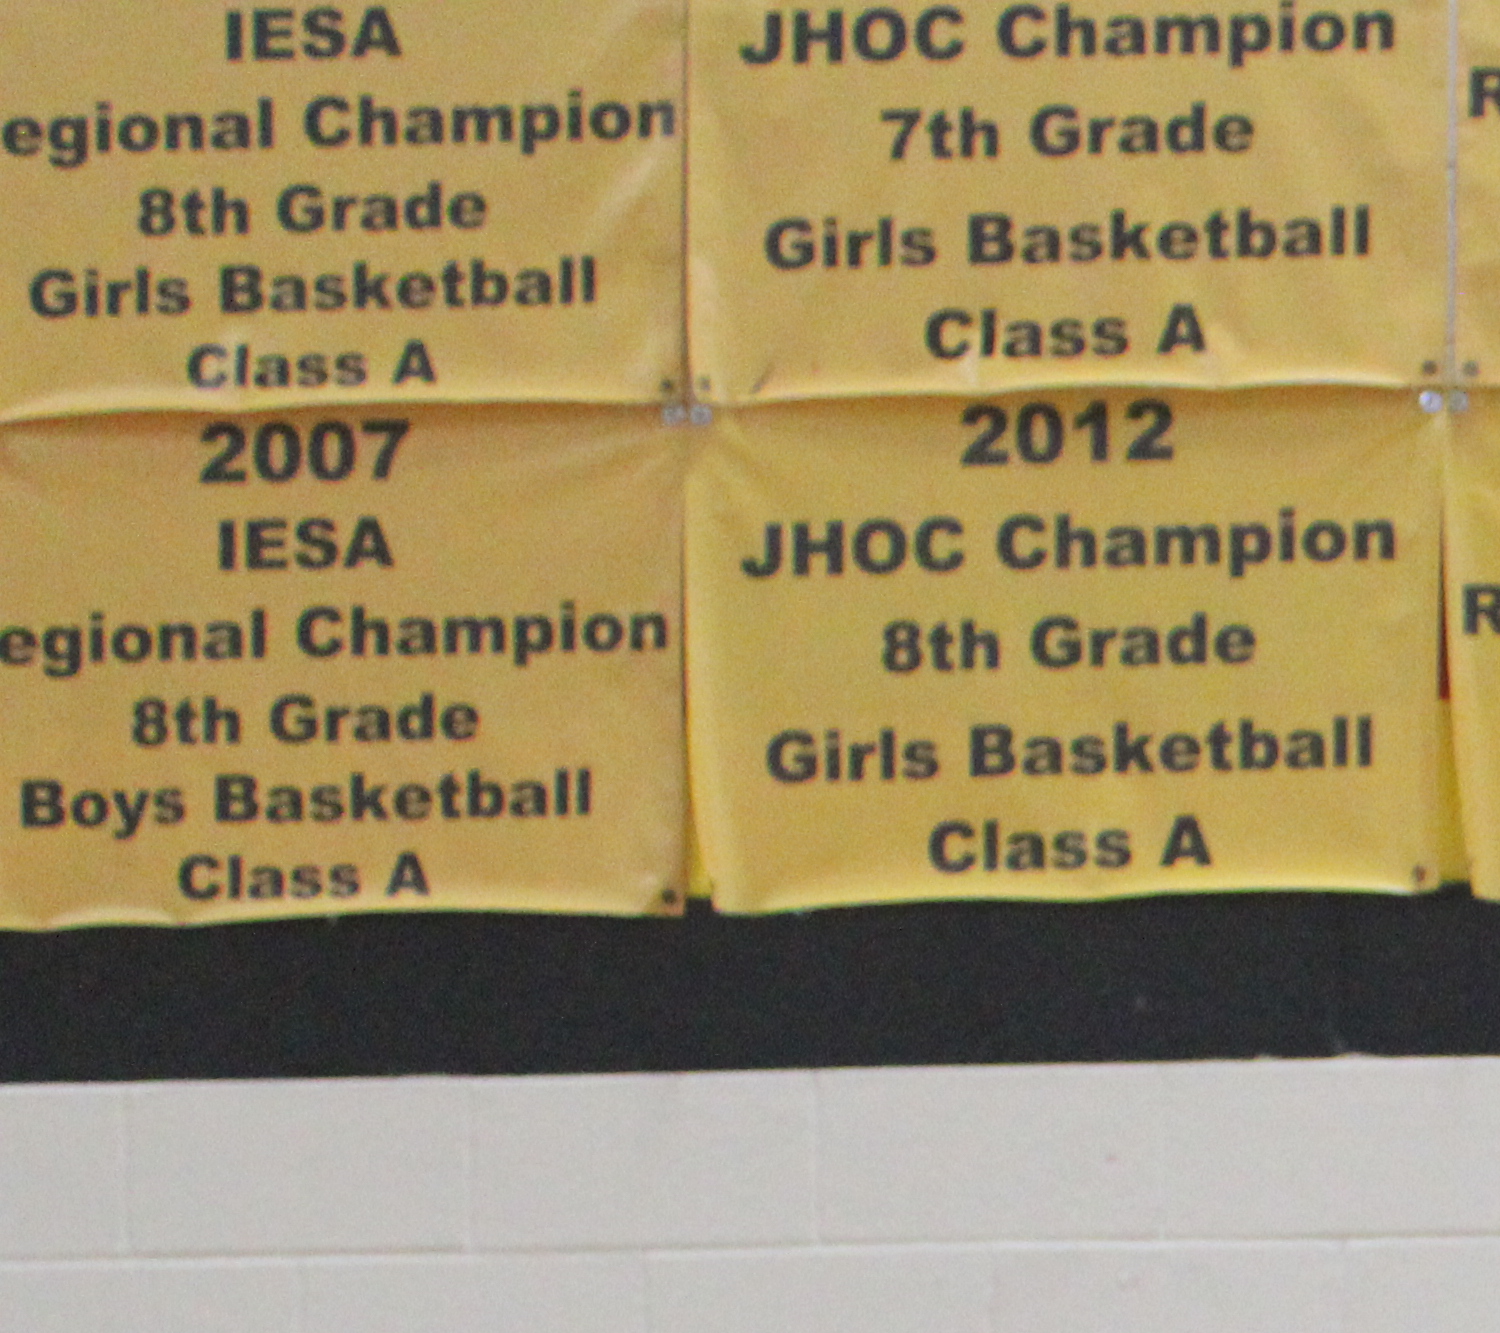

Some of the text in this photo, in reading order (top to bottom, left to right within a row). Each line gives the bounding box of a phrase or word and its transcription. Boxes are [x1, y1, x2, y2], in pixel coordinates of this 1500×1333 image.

[225, 5, 401, 61] IESA
[739, 0, 1395, 68] JHOC Champion
[303, 90, 675, 156] Champion
[880, 101, 1254, 161] 7th Grade
[137, 180, 487, 237] 8th Grade
[764, 204, 1370, 270] Girls Basketball
[28, 255, 595, 319] Girls Basketball
[924, 303, 1206, 360] Class A
[185, 338, 435, 388] Class A
[199, 417, 411, 484] 2007
[960, 399, 1174, 466] 2012
[218, 516, 393, 571] IESA
[740, 507, 1395, 579] JHOC Champion
[296, 600, 667, 667] Champion
[881, 612, 1256, 673] 8th Grade
[131, 692, 478, 747] 8th Grade
[765, 715, 1372, 784] Girls Basketball
[20, 767, 591, 840] Boys Basketball
[927, 814, 1211, 873] Class A
[177, 850, 429, 902] Class A
